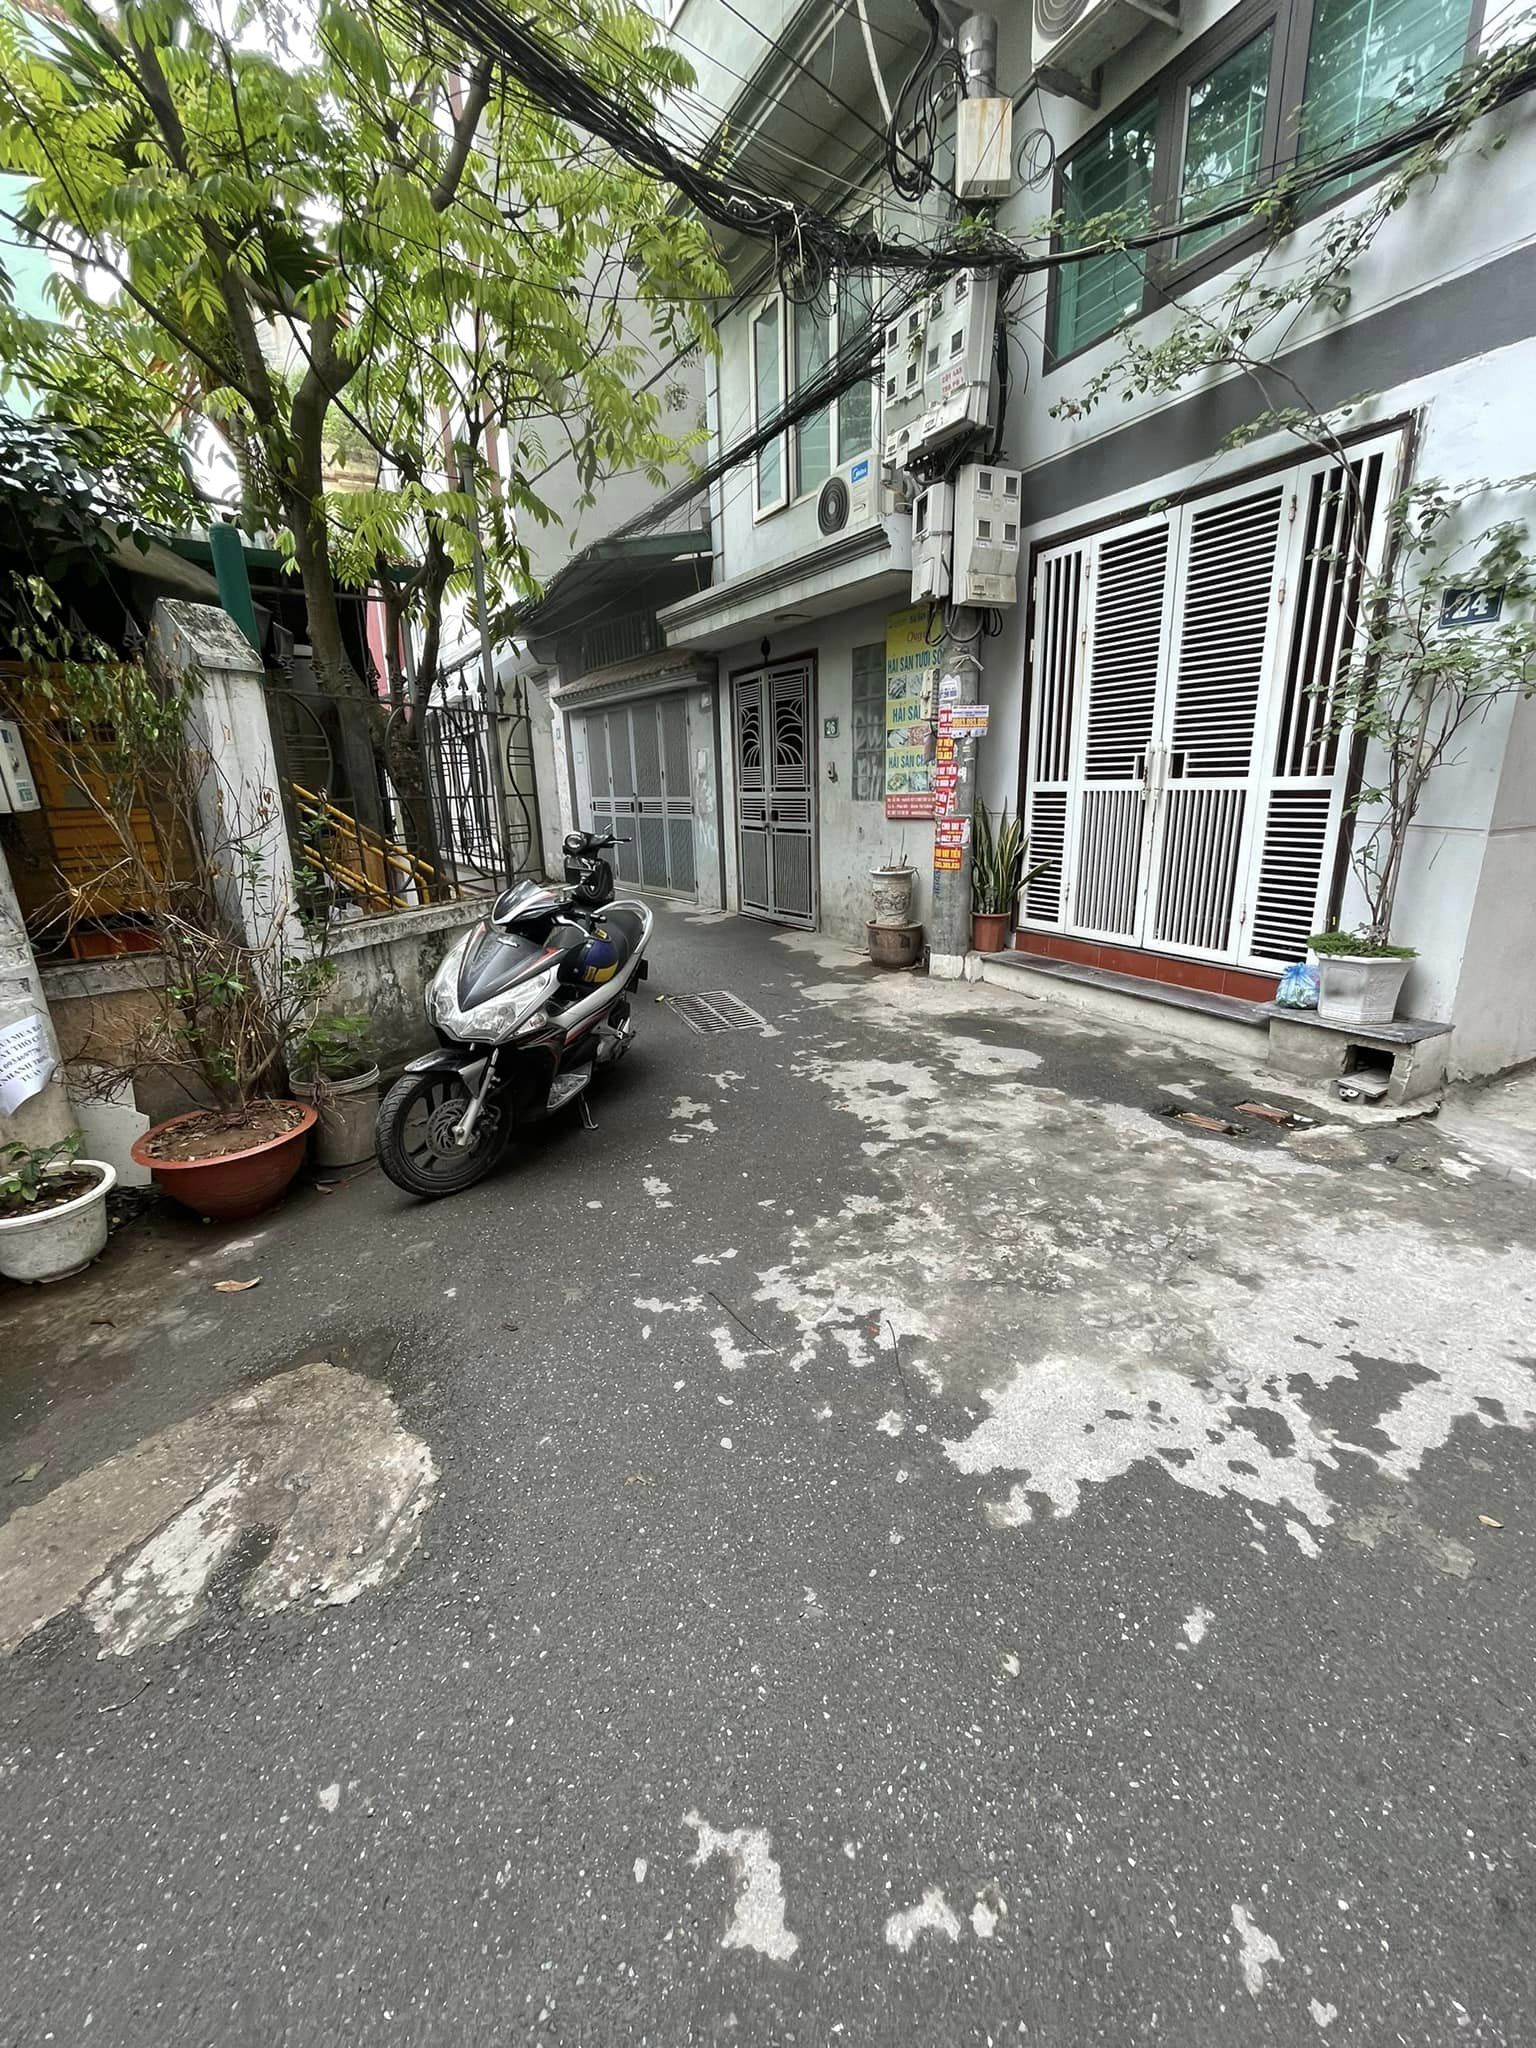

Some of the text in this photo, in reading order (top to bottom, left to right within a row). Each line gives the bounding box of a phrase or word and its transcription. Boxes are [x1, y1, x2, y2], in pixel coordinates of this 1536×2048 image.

[1451, 592, 1490, 620] 24
[892, 702, 906, 722] HẢI
[888, 751, 900, 769] HẢI
[901, 751, 915, 769] SẢN
